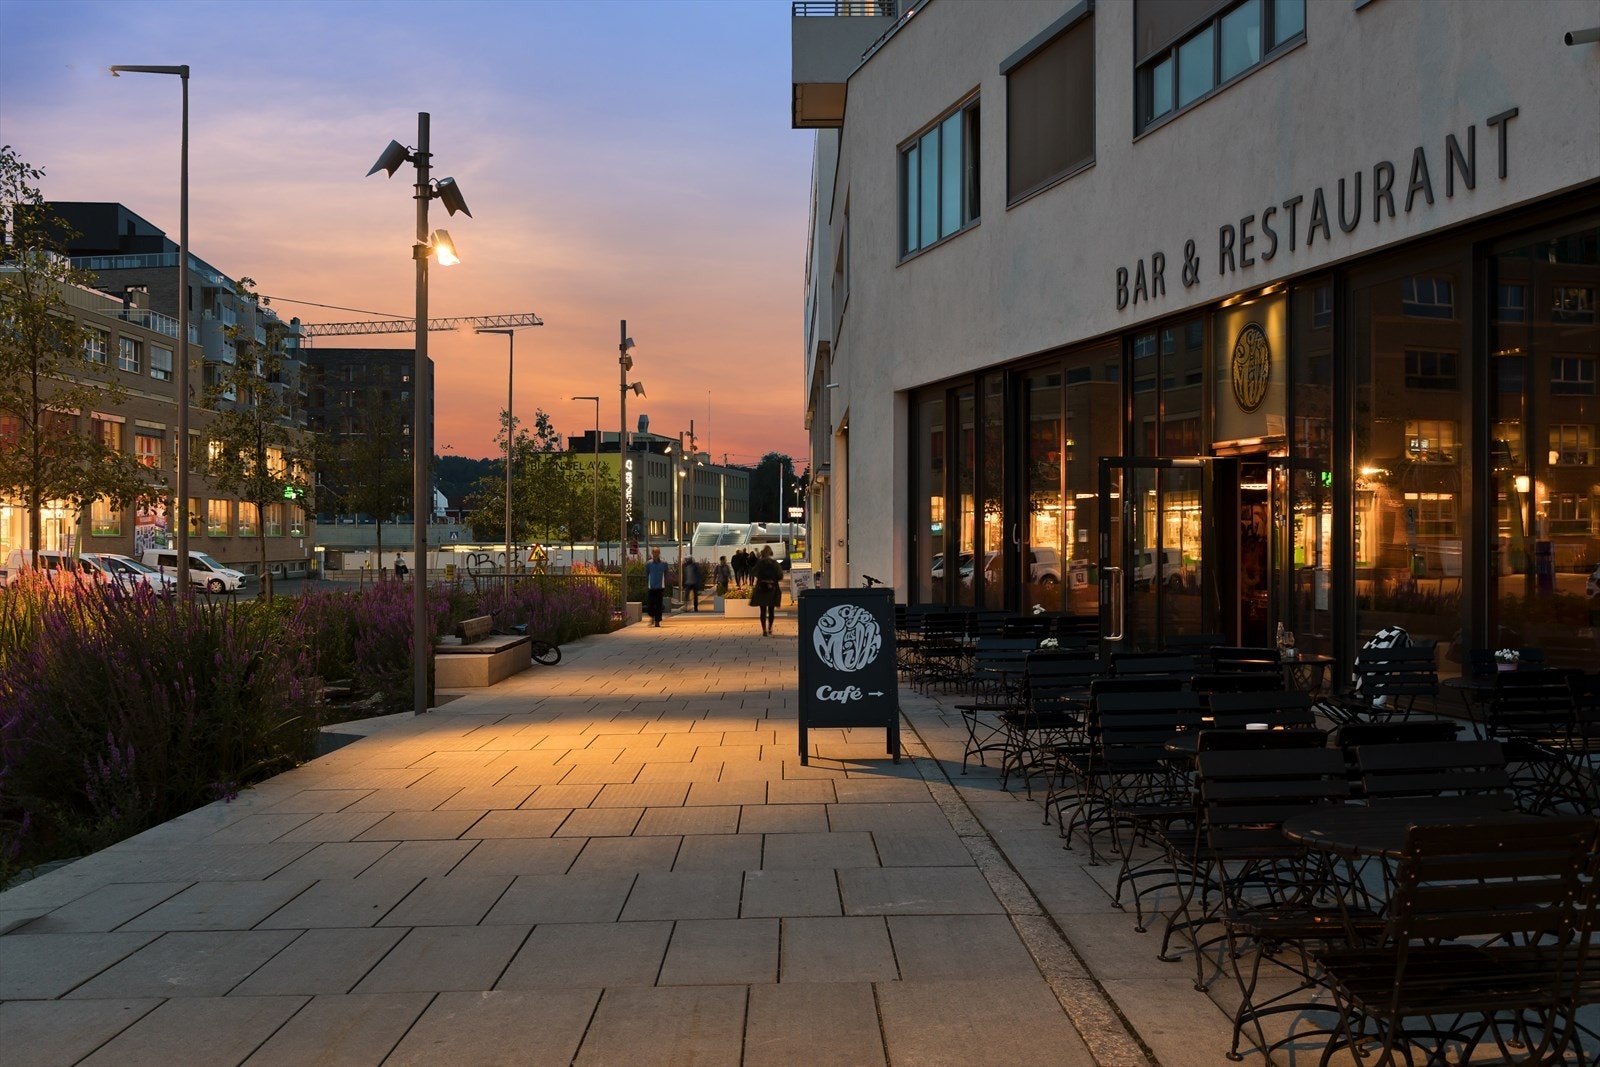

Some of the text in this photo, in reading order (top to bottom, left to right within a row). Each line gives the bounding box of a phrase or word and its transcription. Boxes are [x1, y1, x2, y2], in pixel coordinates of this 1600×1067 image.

[1116, 107, 1519, 310] BAR & RESTAURANT
[817, 604, 873, 634] Safe
[813, 620, 882, 672] Milk
[816, 685, 863, 704] Café
